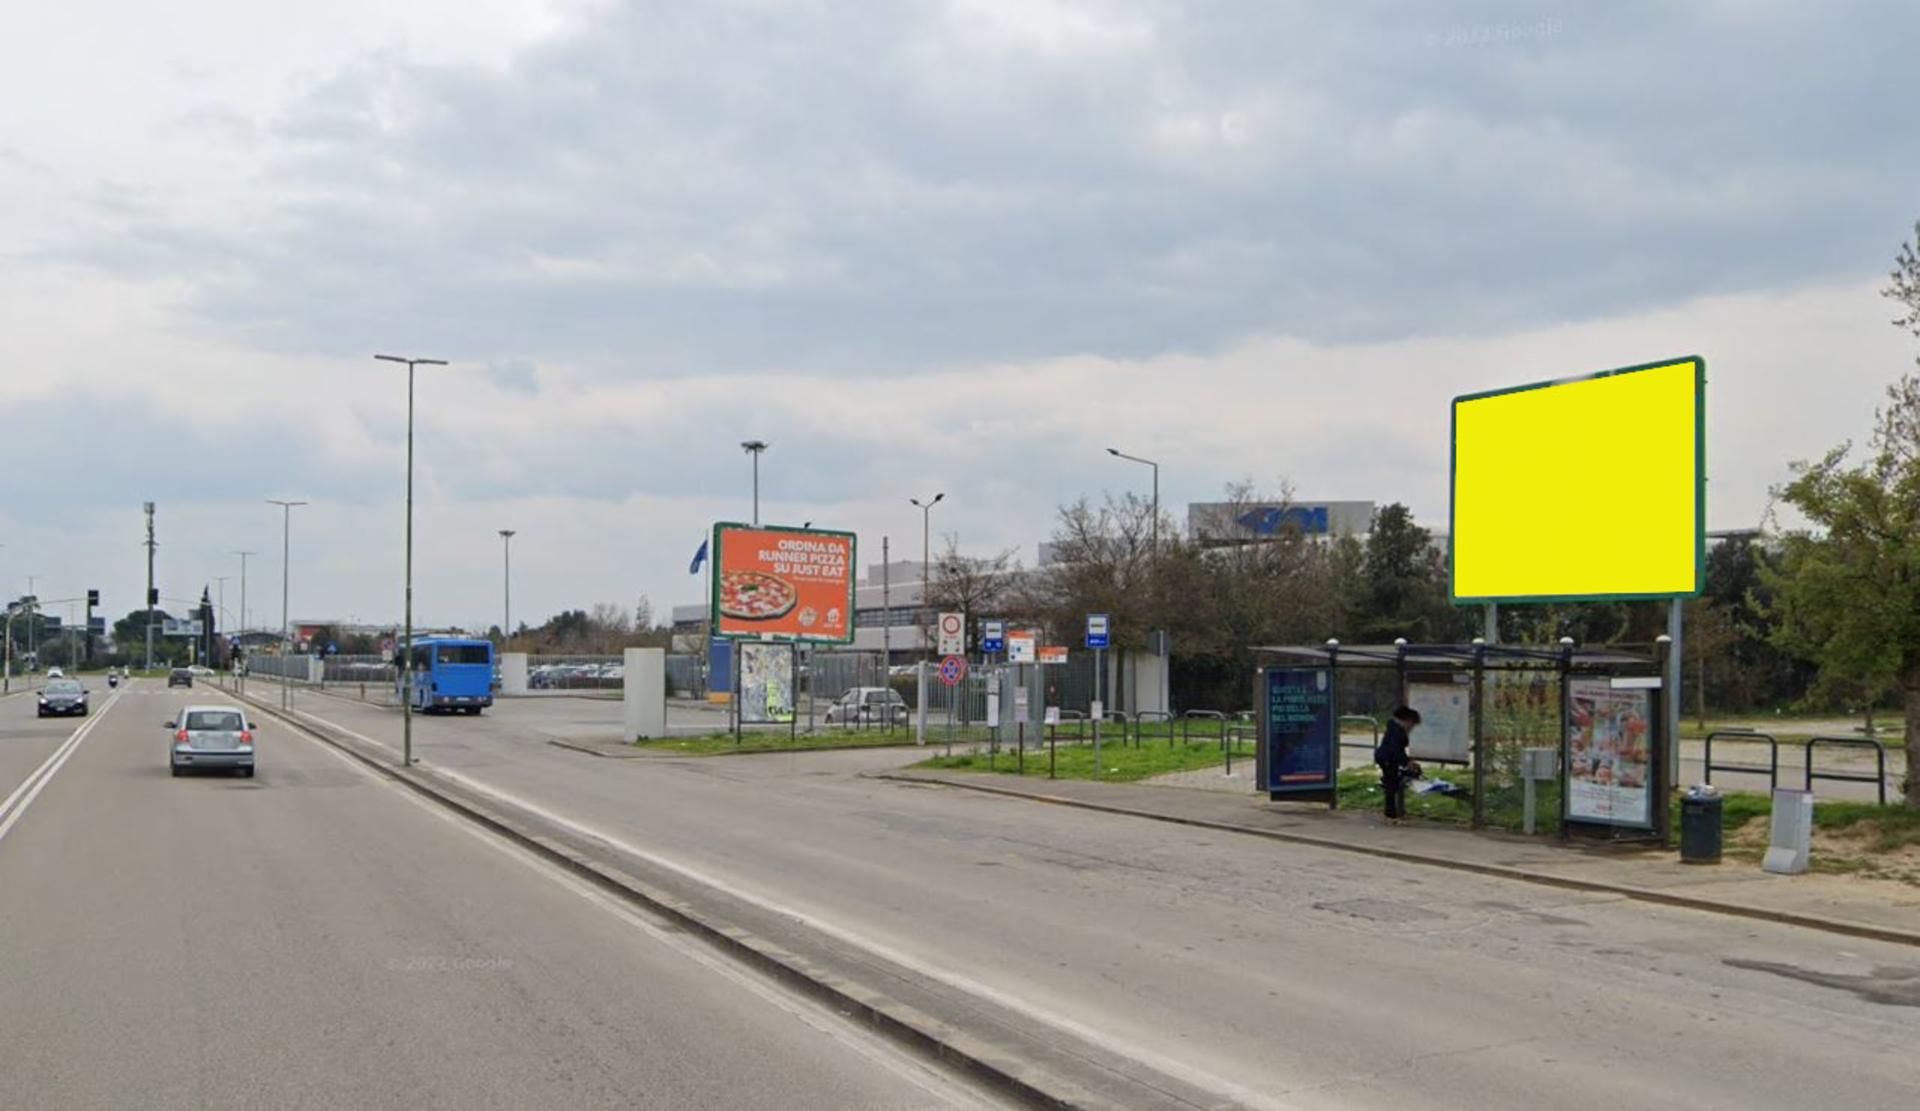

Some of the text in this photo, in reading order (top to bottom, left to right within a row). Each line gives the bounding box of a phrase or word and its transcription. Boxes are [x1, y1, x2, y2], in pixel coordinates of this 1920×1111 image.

[778, 540, 845, 554] ORDINA DA
[758, 550, 845, 565] RUNNER PIZZA
[774, 562, 845, 577] SU JUST EAT
